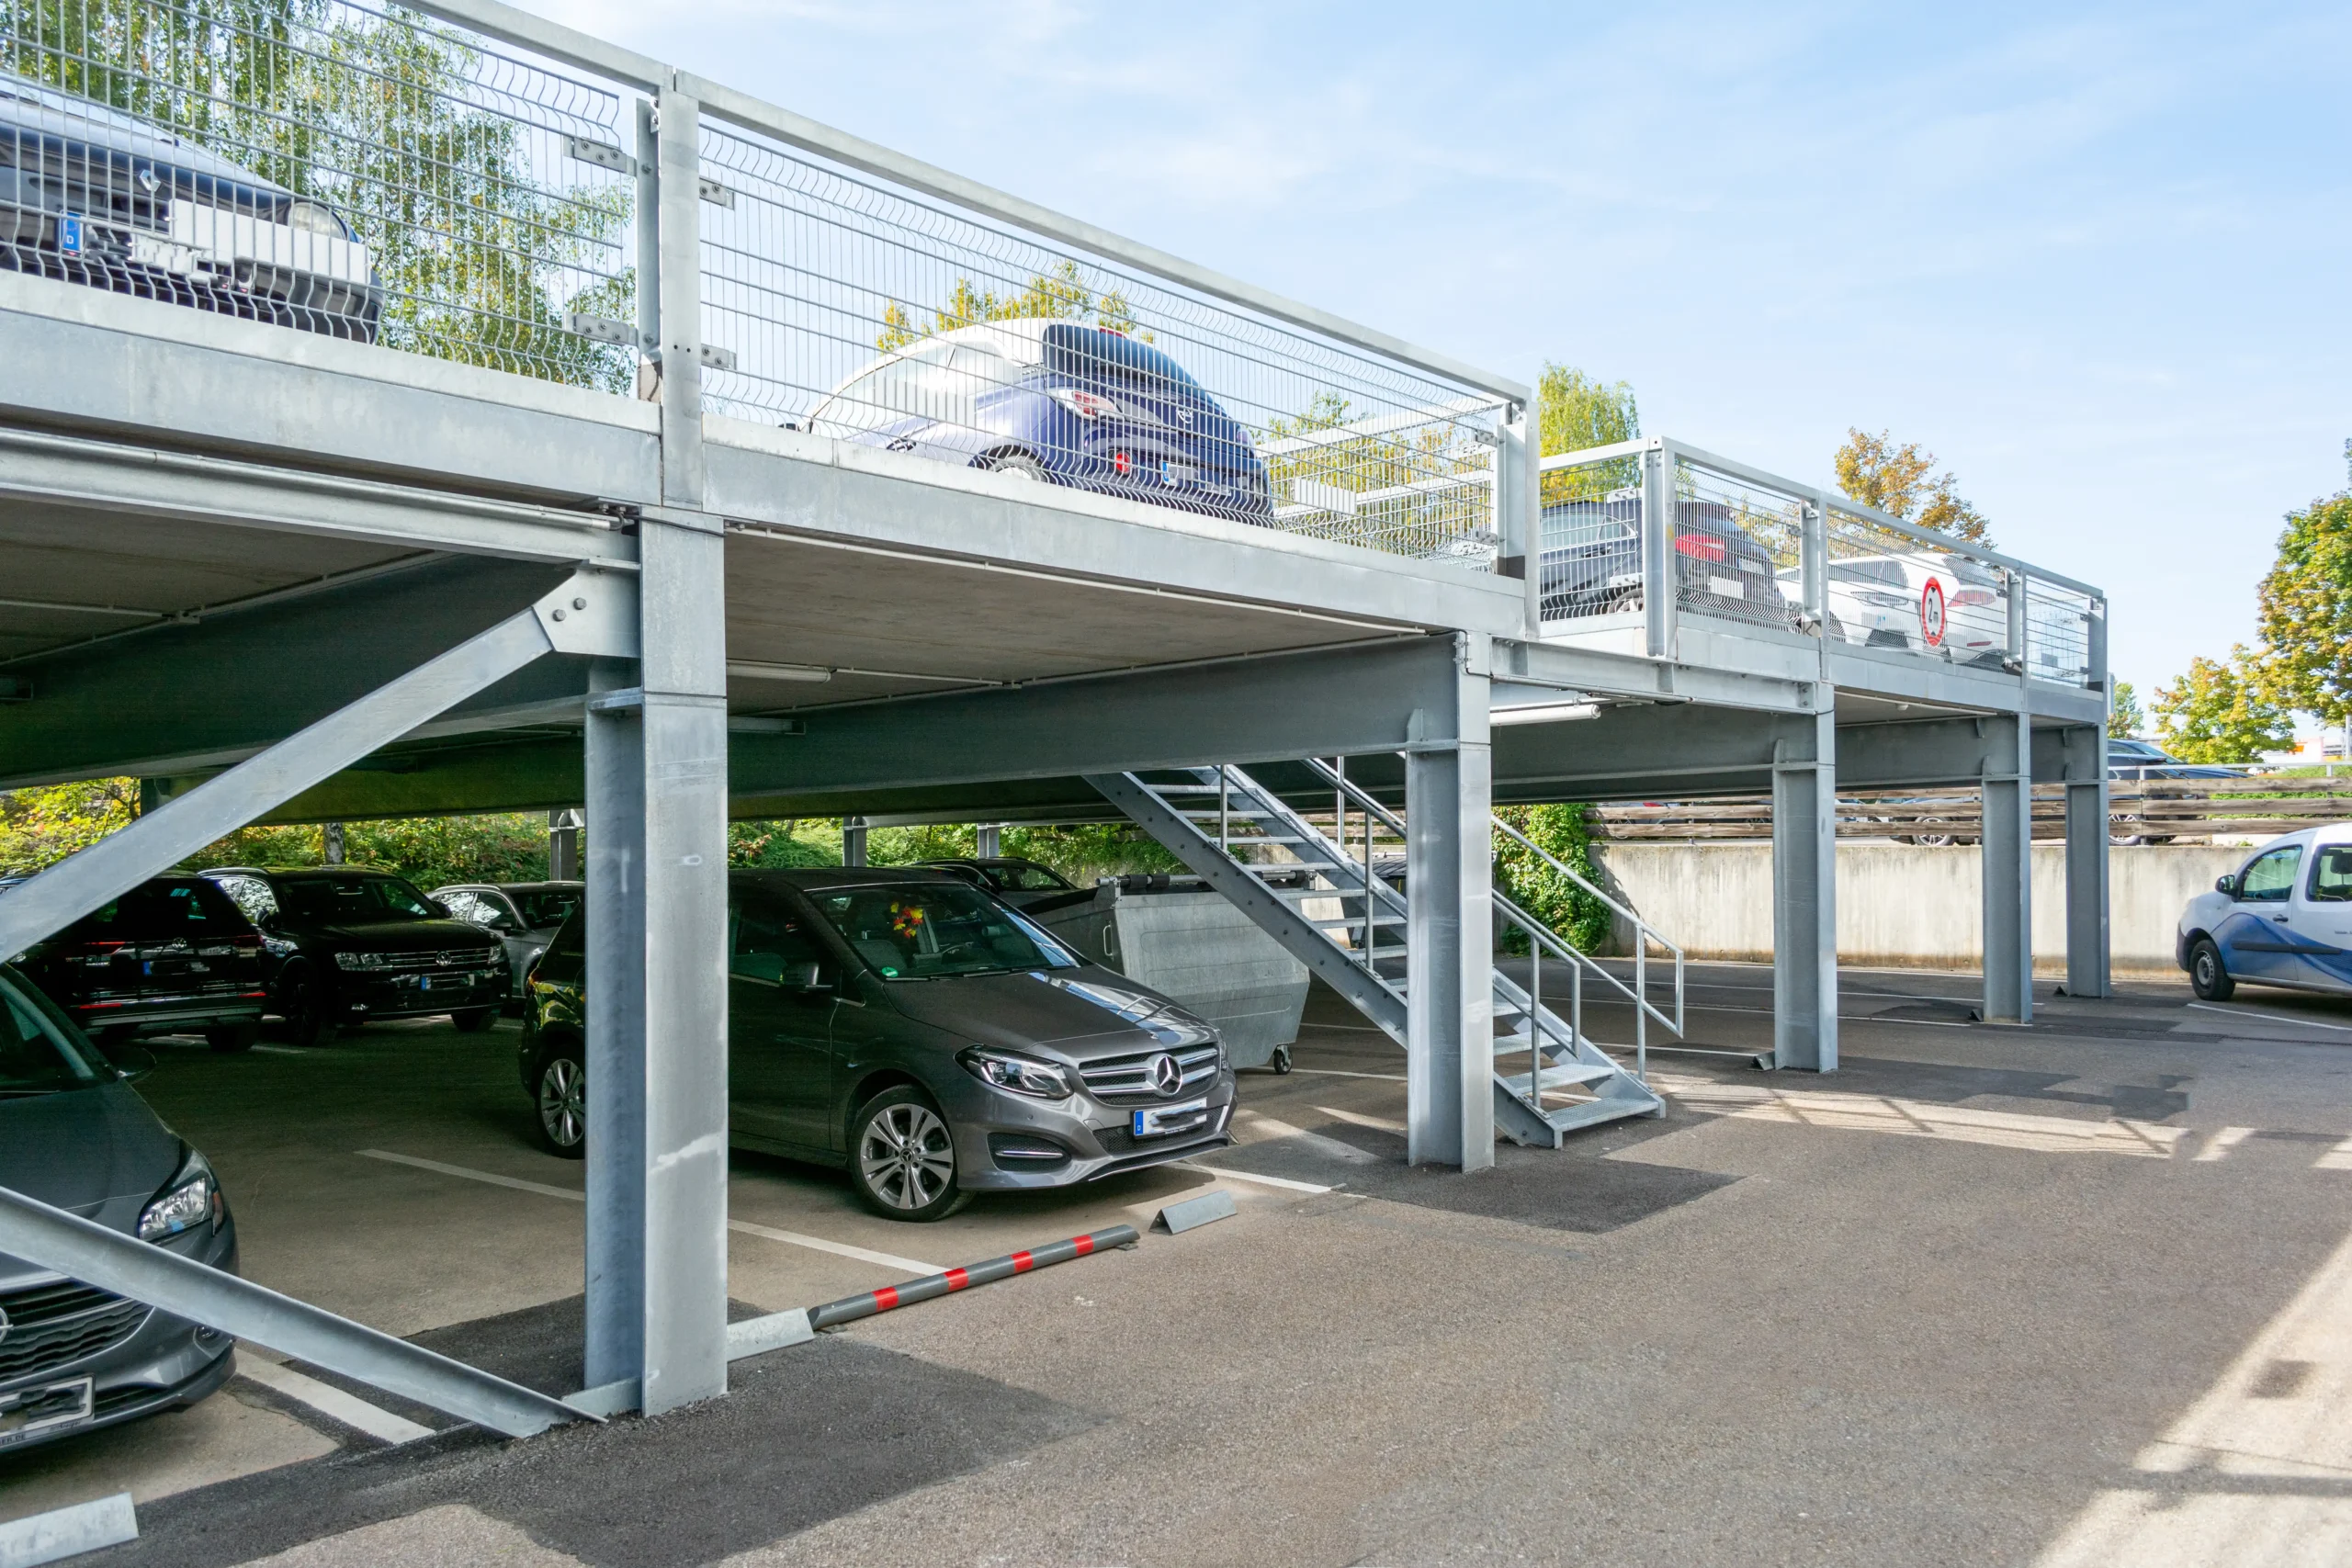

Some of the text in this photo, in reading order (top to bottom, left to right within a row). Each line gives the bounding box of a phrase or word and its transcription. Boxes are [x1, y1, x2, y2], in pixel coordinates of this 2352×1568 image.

[67, 235, 74, 243] D
[1928, 598, 1932, 623] 2
[0, 1433, 26, 1446] ER.DE
